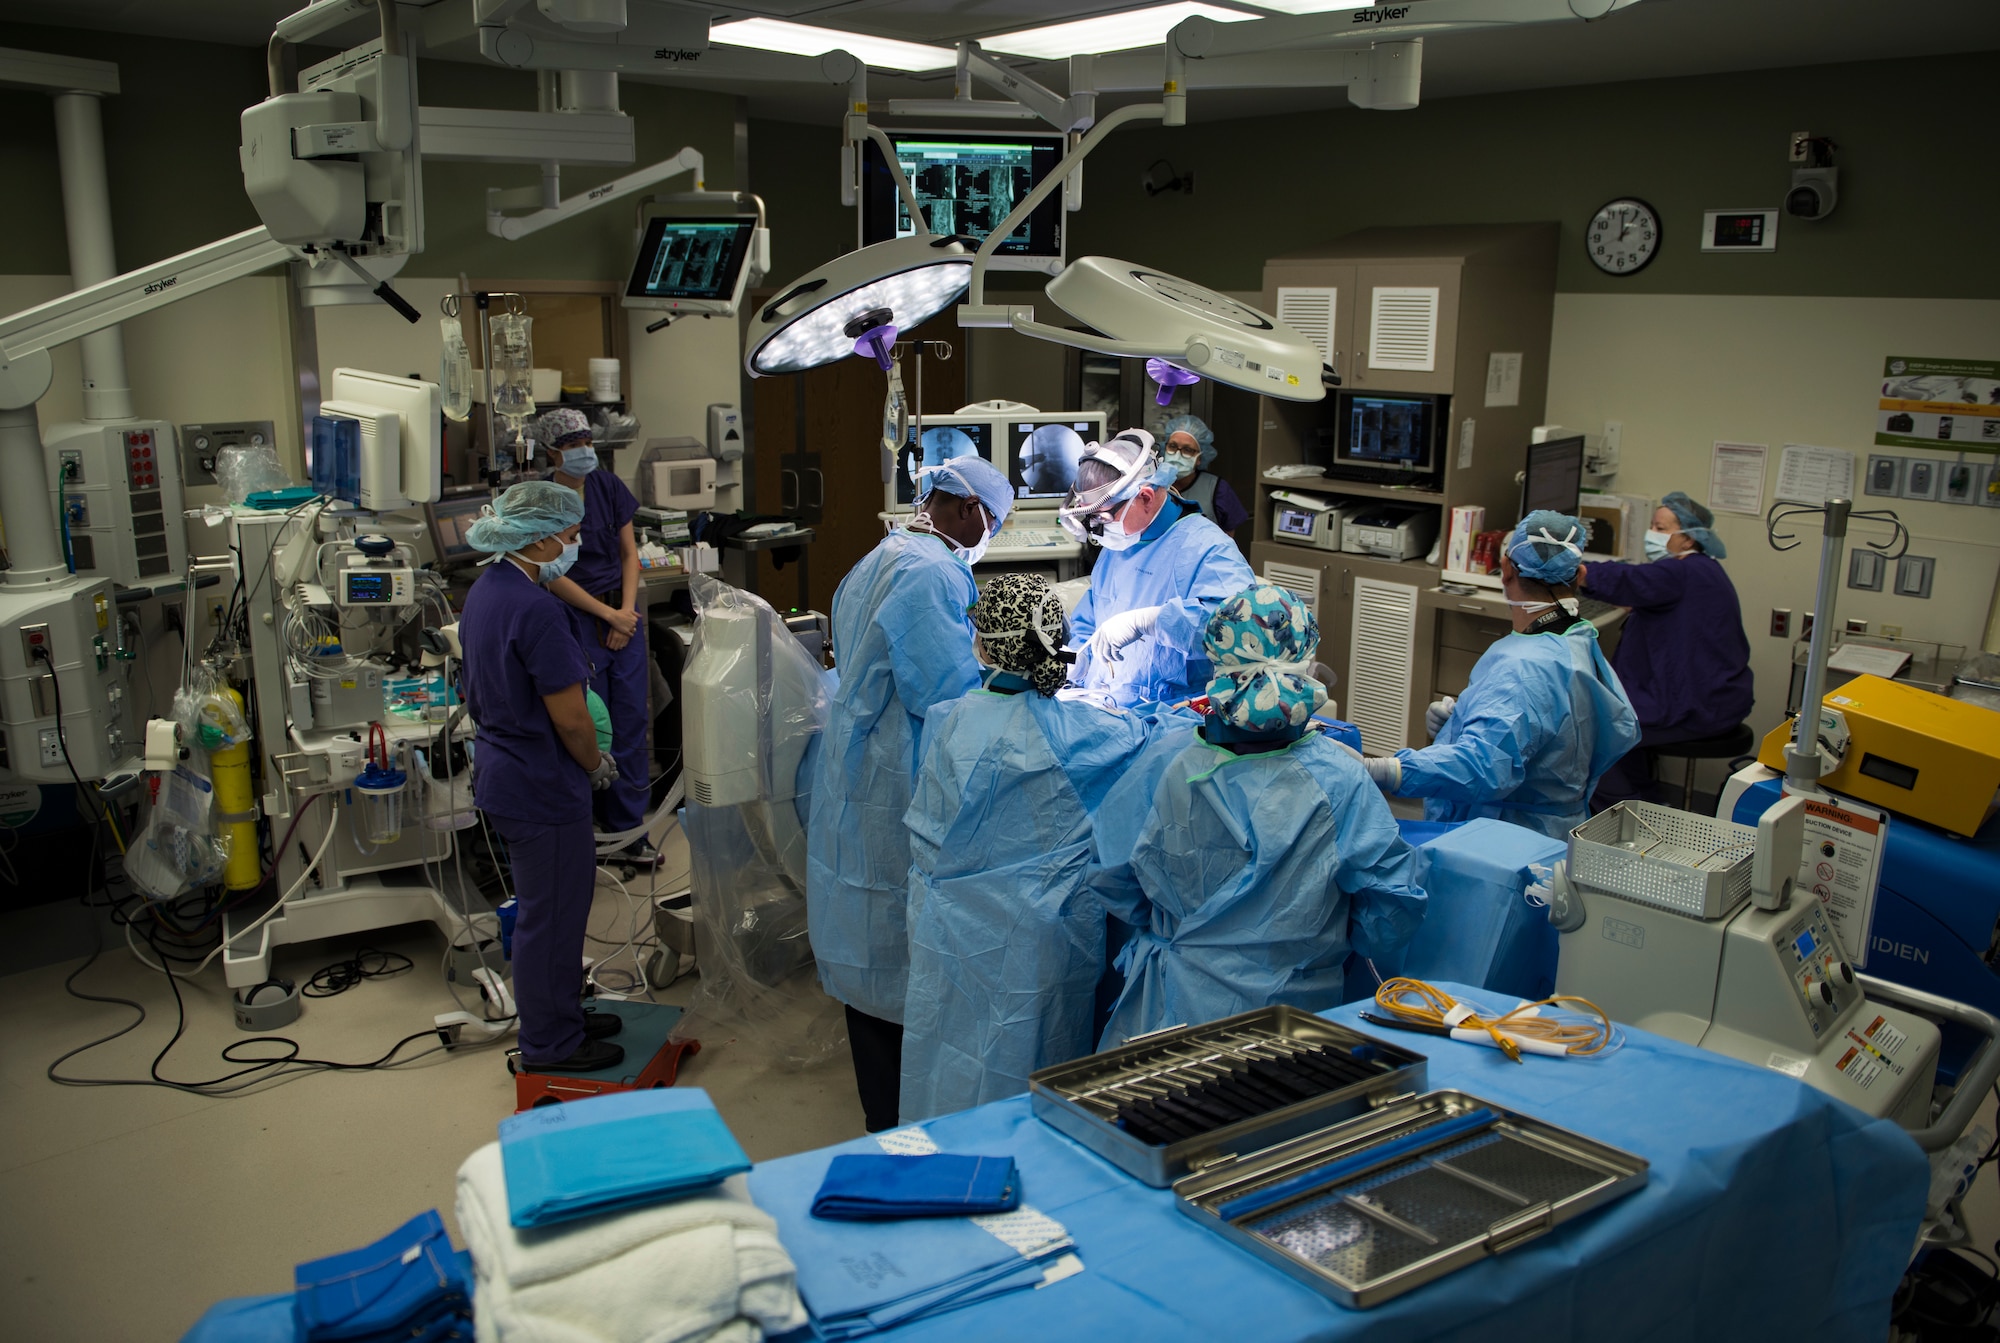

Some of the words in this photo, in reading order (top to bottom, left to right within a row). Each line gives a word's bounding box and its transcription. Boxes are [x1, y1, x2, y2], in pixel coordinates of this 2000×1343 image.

[1352, 6, 1409, 23] stryker
[654, 48, 701, 61] stryker
[588, 184, 614, 200] stryker
[1607, 211, 1615, 220] 11
[1618, 207, 1629, 215] 12
[1597, 221, 1608, 230] 10
[1640, 218, 1648, 227] 2
[1593, 234, 1601, 243] 9
[1643, 231, 1651, 240] 3
[1597, 246, 1605, 255] 8
[1638, 244, 1646, 252] 4
[1606, 254, 1613, 263] 7
[1629, 253, 1637, 262] 5
[1617, 258, 1625, 267] 6
[144, 277, 177, 295] stryker
[1806, 803, 1853, 823] WARNING:
[1805, 819, 1831, 830] SUCTION
[1832, 826, 1852, 838] DEVICE
